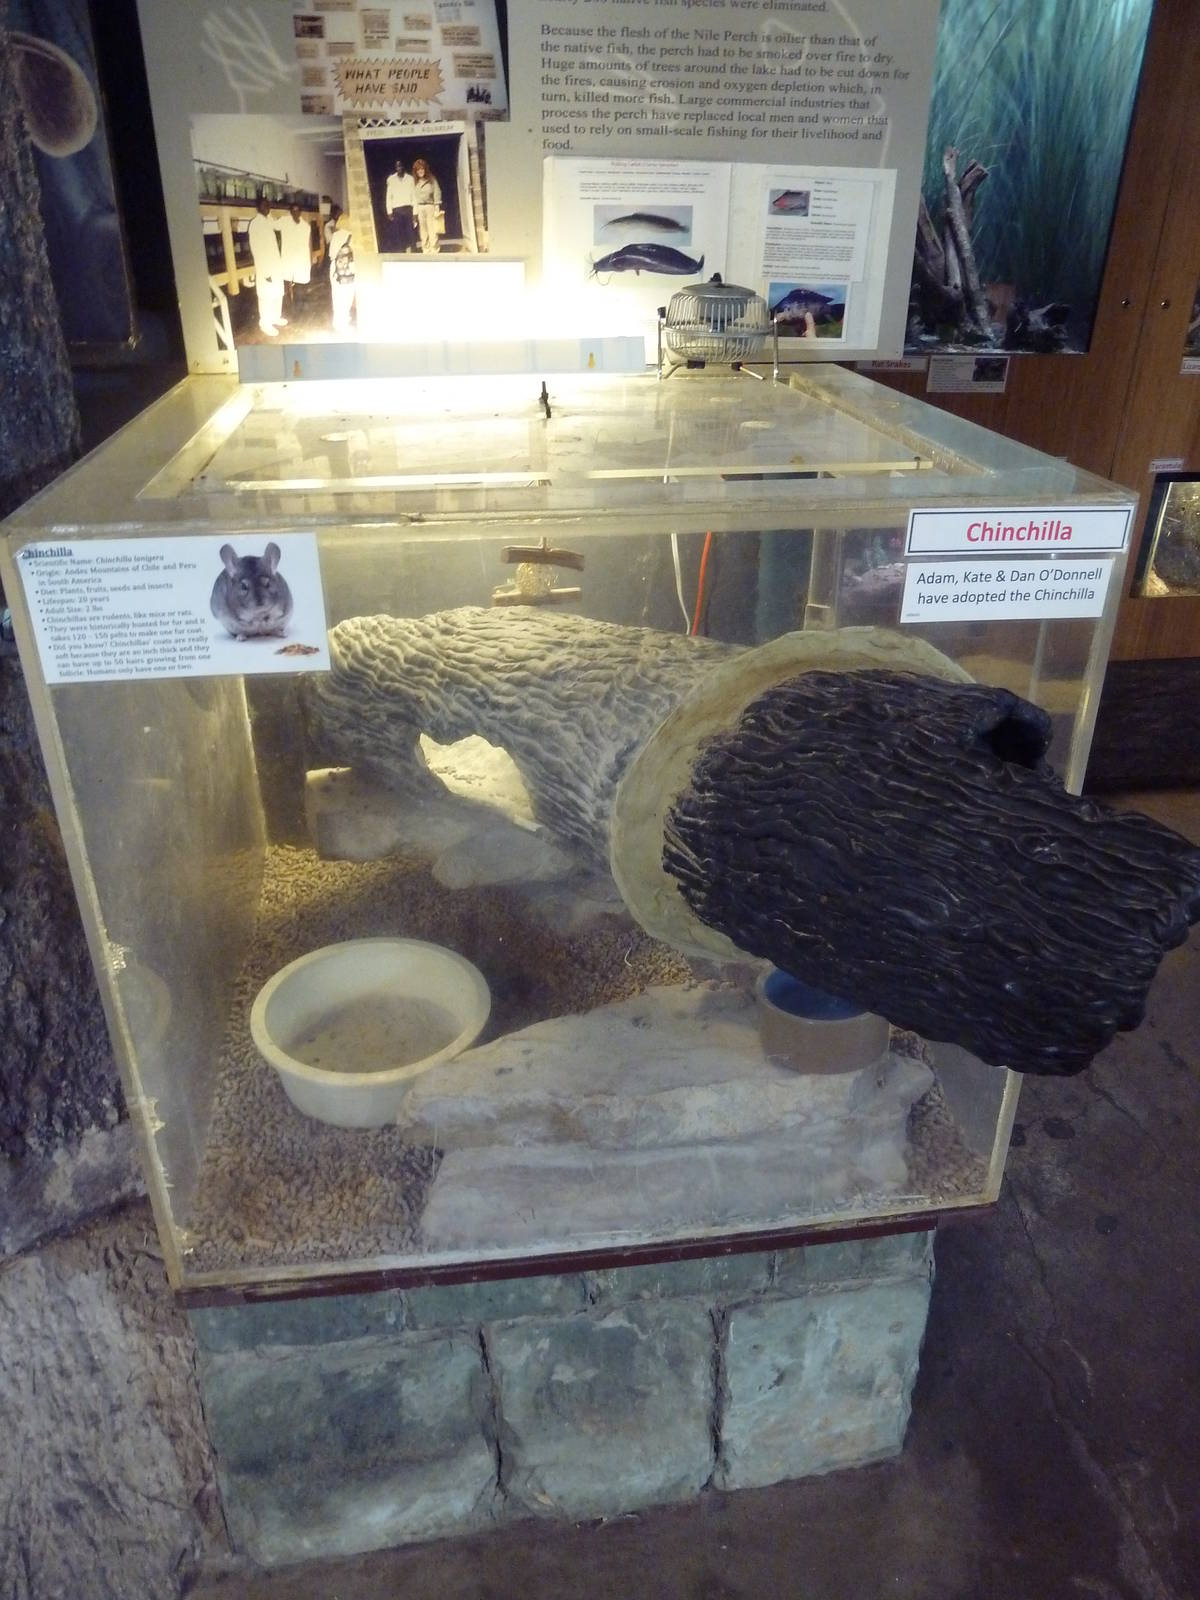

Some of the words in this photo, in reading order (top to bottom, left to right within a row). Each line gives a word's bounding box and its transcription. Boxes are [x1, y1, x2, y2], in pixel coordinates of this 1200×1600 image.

[680, 0, 725, 11] species
[730, 2, 758, 10] were
[762, 0, 828, 13] eliminated.
[540, 23, 593, 36] Because
[596, 26, 616, 37] the
[620, 26, 650, 38] flesh
[653, 28, 666, 39] of
[670, 28, 689, 40] the
[693, 29, 720, 41] Nile
[723, 30, 758, 42] Perch
[809, 34, 835, 45] than
[838, 35, 860, 46] that
[863, 36, 877, 47] of
[540, 41, 560, 52] the
[563, 42, 602, 53] native
[636, 44, 656, 55] the
[659, 45, 693, 59] perch
[697, 46, 719, 57] had
[722, 48, 735, 58] to
[738, 47, 752, 58] be
[755, 48, 802, 60] smoked
[805, 52, 831, 61] over
[835, 50, 856, 62] fire
[858, 52, 871, 62] to
[345, 69, 380, 80] WHAT
[388, 68, 430, 79] PEOPLE
[540, 58, 574, 71] Huge
[578, 60, 631, 71] amounts
[634, 60, 649, 71] of
[651, 62, 680, 72] trees
[684, 62, 726, 74] around
[729, 63, 748, 74] the
[752, 64, 776, 75] lake
[779, 65, 801, 76] had
[804, 66, 816, 76] to
[819, 66, 833, 77] be
[836, 67, 854, 77] cut
[857, 67, 889, 78] down
[893, 68, 910, 79] for
[355, 83, 386, 94] HAVE
[392, 83, 418, 94] SAID
[540, 74, 560, 85] the
[600, 76, 646, 90] causing
[649, 77, 694, 89] erosion
[698, 79, 720, 90] and
[723, 82, 767, 93] oxygen
[770, 80, 824, 95] depletion
[870, 83, 882, 94] in
[573, 91, 609, 103] killed
[613, 95, 644, 104] more
[679, 94, 712, 108] Large
[716, 95, 786, 107] commercial
[789, 97, 845, 109] industries
[848, 98, 870, 110] that
[541, 109, 588, 120] process
[591, 108, 610, 119] the
[613, 108, 647, 122] perch
[651, 109, 680, 120] have
[683, 110, 733, 124] replaced
[737, 111, 765, 122] local
[769, 114, 794, 123] men
[797, 113, 818, 124] and
[822, 116, 863, 125] women
[867, 114, 888, 125] that
[542, 123, 570, 134] used
[573, 124, 586, 134] to
[589, 124, 613, 137] rely
[616, 127, 632, 135] on
[635, 125, 702, 137] small-scale
[706, 126, 747, 140] fishing
[751, 127, 766, 138] for
[771, 128, 798, 138] their
[801, 128, 858, 140] livelihood
[861, 129, 882, 140] and
[542, 139, 573, 150] food.
[967, 521, 1073, 542] Chinchilla
[916, 571, 958, 585] Adam,
[963, 571, 992, 583] Kate
[996, 570, 1006, 583] &
[1010, 570, 1035, 582] Dan
[1039, 568, 1102, 581] O'Donnell
[918, 592, 948, 604] have
[952, 590, 1006, 605] adopted
[1010, 590, 1030, 601] the
[1034, 588, 1095, 600] Chinchilla
